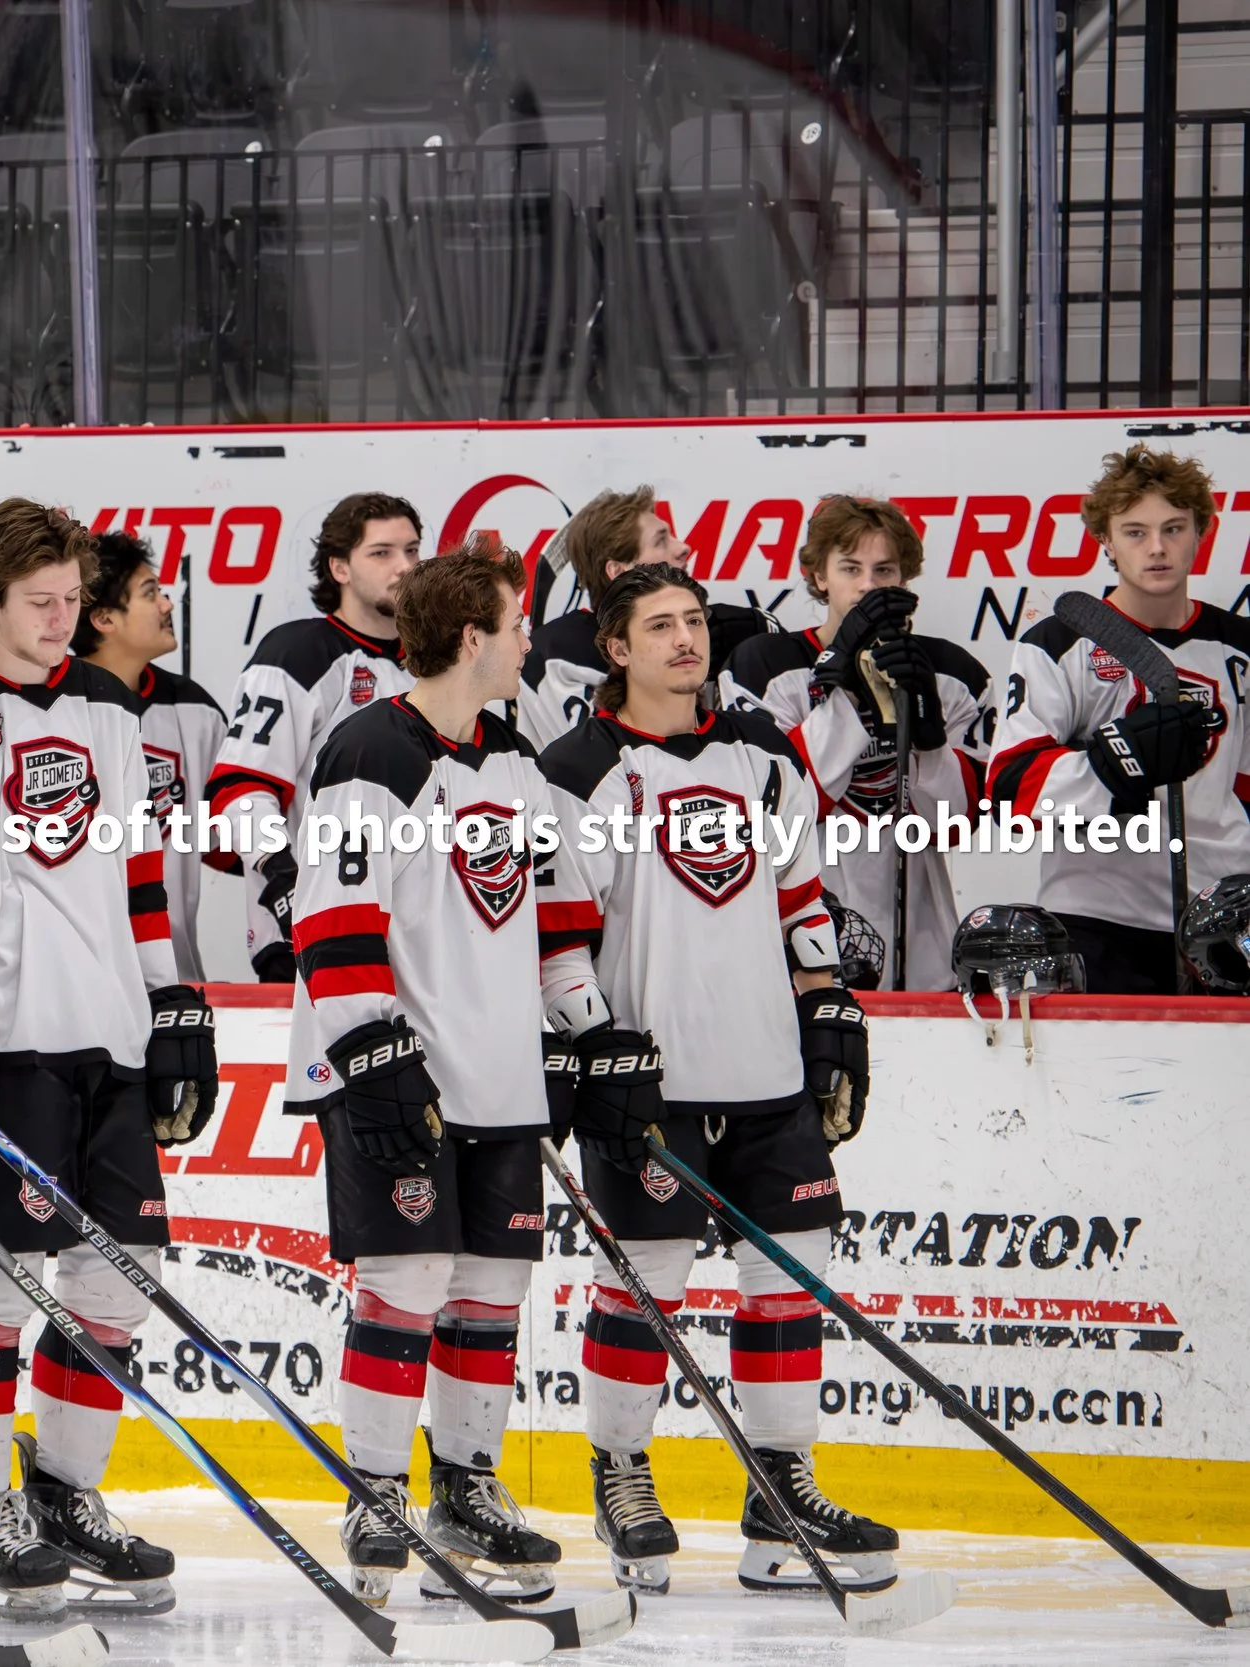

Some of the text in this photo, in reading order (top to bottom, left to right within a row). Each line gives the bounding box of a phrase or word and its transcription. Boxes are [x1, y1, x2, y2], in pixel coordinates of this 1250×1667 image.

[227, 692, 284, 746] 27
[26, 761, 83, 791] JR COMETS
[28, 753, 56, 767] UTICA
[338, 830, 369, 886] 8
[152, 1009, 215, 1029] BAU
[89, 1232, 157, 1297] BAUER
[20, 1274, 84, 1337] BAUER
[370, 1503, 437, 1562] FLYLITE
[797, 1519, 831, 1539] AUER
[275, 1533, 336, 1590] FLYLITE
